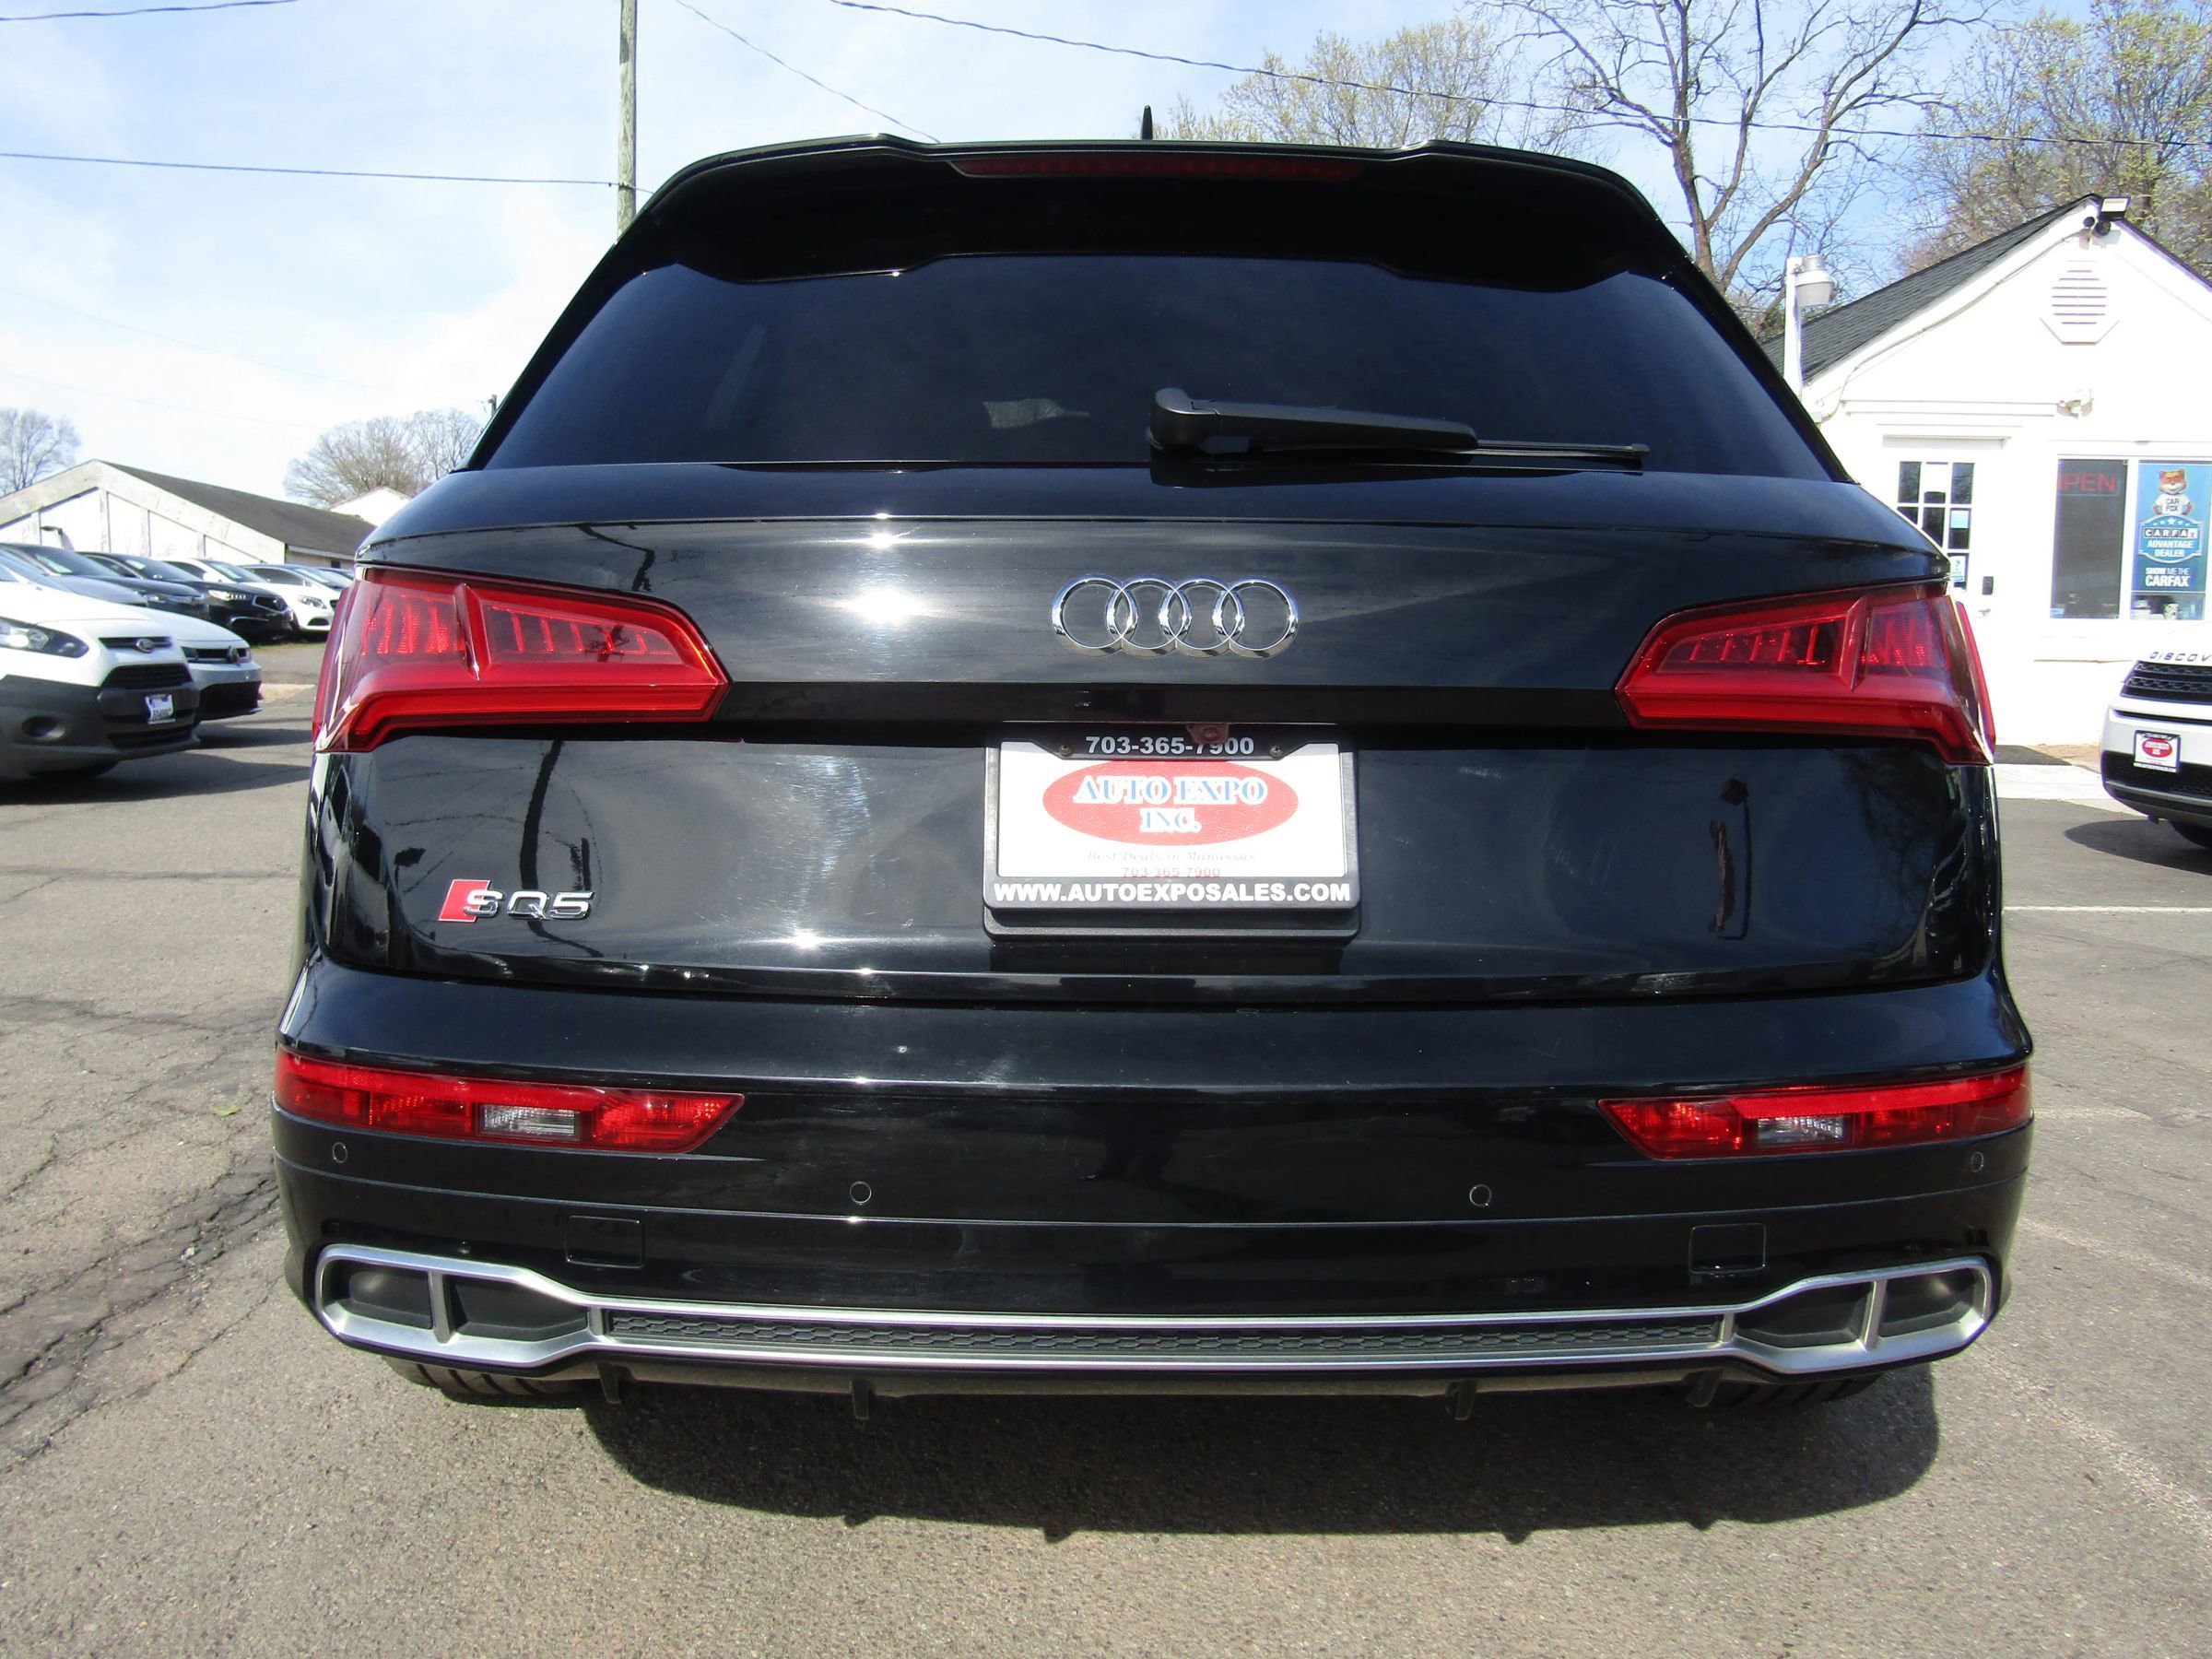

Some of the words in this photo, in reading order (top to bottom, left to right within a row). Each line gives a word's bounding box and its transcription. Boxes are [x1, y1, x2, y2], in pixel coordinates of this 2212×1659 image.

[2058, 472, 2117, 492] PEN
[2146, 528, 2197, 538] CARFAX
[2147, 540, 2194, 548] ADVANTAGE
[2146, 575, 2191, 586] CARFAX
[1074, 775, 1171, 804] AUTO
[1174, 776, 1268, 805] EXPO
[1140, 808, 1202, 833] INC.
[1088, 851, 1116, 862] Best
[1122, 851, 1161, 862] Deals
[1167, 851, 1181, 862] in
[1121, 866, 1221, 877] 703-365-7900
[994, 882, 1351, 902] WWW.AUTOEXPOSALES.COM
[463, 889, 595, 921] SQ5
